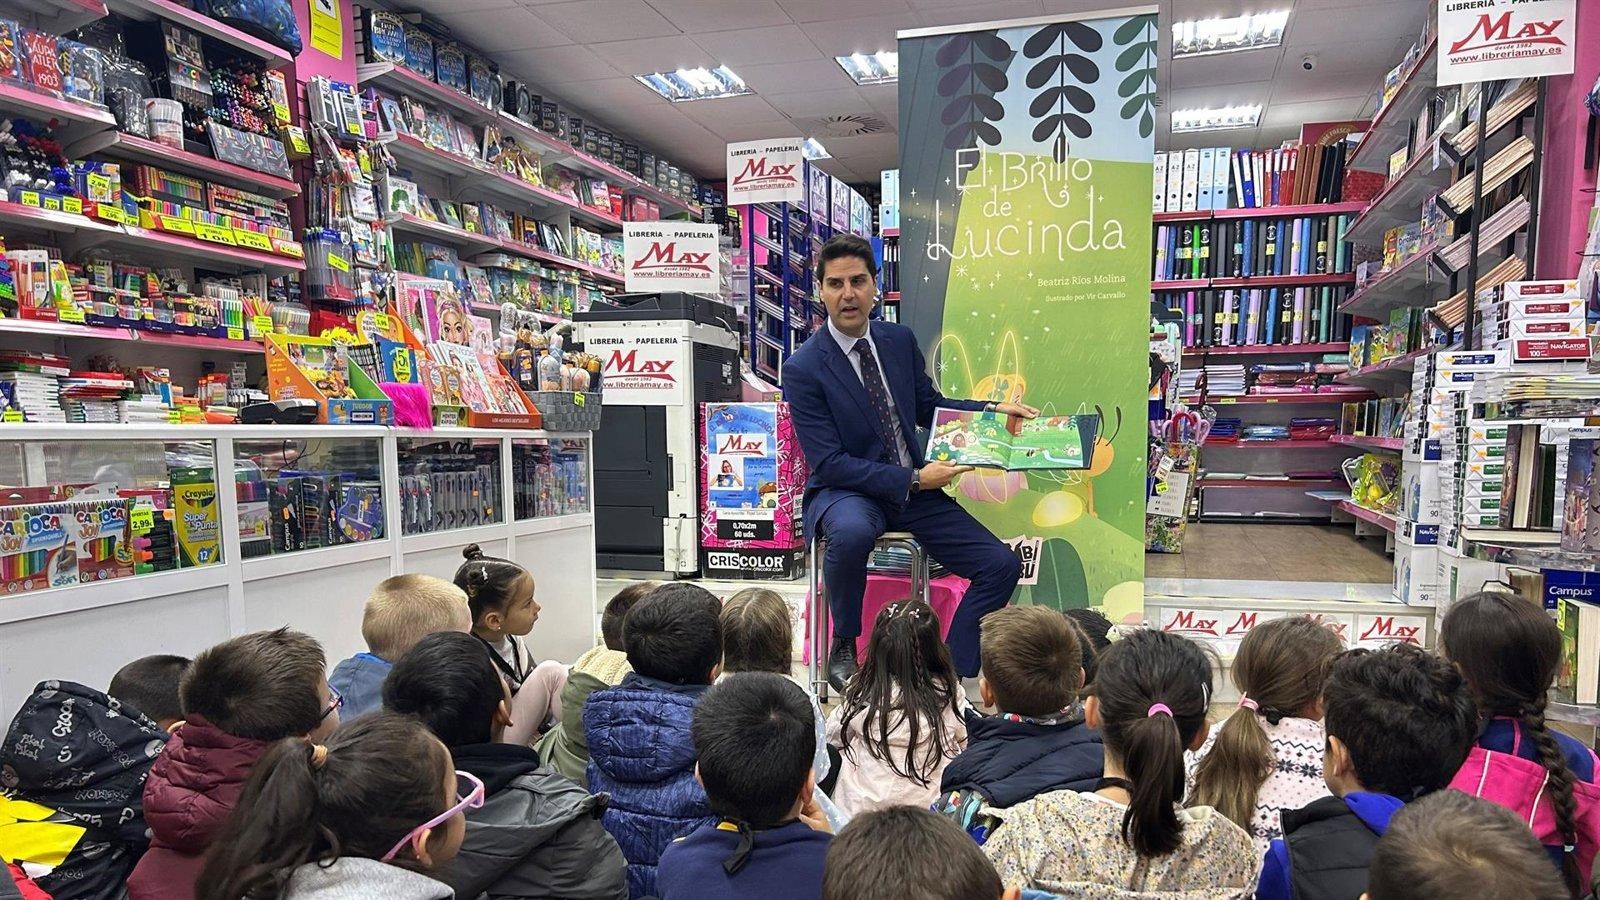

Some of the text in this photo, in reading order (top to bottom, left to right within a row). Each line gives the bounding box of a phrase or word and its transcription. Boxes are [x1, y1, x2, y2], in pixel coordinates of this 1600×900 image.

[1446, 0, 1495, 12] LIBRERIA
[1450, 46, 1562, 64] www.libreriamay.es
[38, 72, 59, 87] 1903
[731, 149, 757, 157] LIBRERIA
[955, 140, 986, 190] El
[733, 182, 795, 191] www.libreriamay.es
[983, 184, 1012, 217] de
[927, 185, 1126, 262] Lucinda
[674, 231, 714, 239] PAPELERIA
[633, 270, 711, 278] www.libreriamay.es
[1037, 276, 1070, 288] Beatriz
[1094, 273, 1126, 285] Molina
[1046, 293, 1073, 302] Ilustrado
[1074, 295, 1085, 303] por
[1086, 292, 1096, 300] Vir
[185, 489, 213, 499] Crayola
[184, 511, 208, 522] Super
[1430, 510, 1439, 518] 90
[200, 550, 208, 561] 12
[710, 554, 783, 568] CRISCOLOR
[1420, 593, 1429, 601] 90
[1549, 585, 1593, 598] Campus
